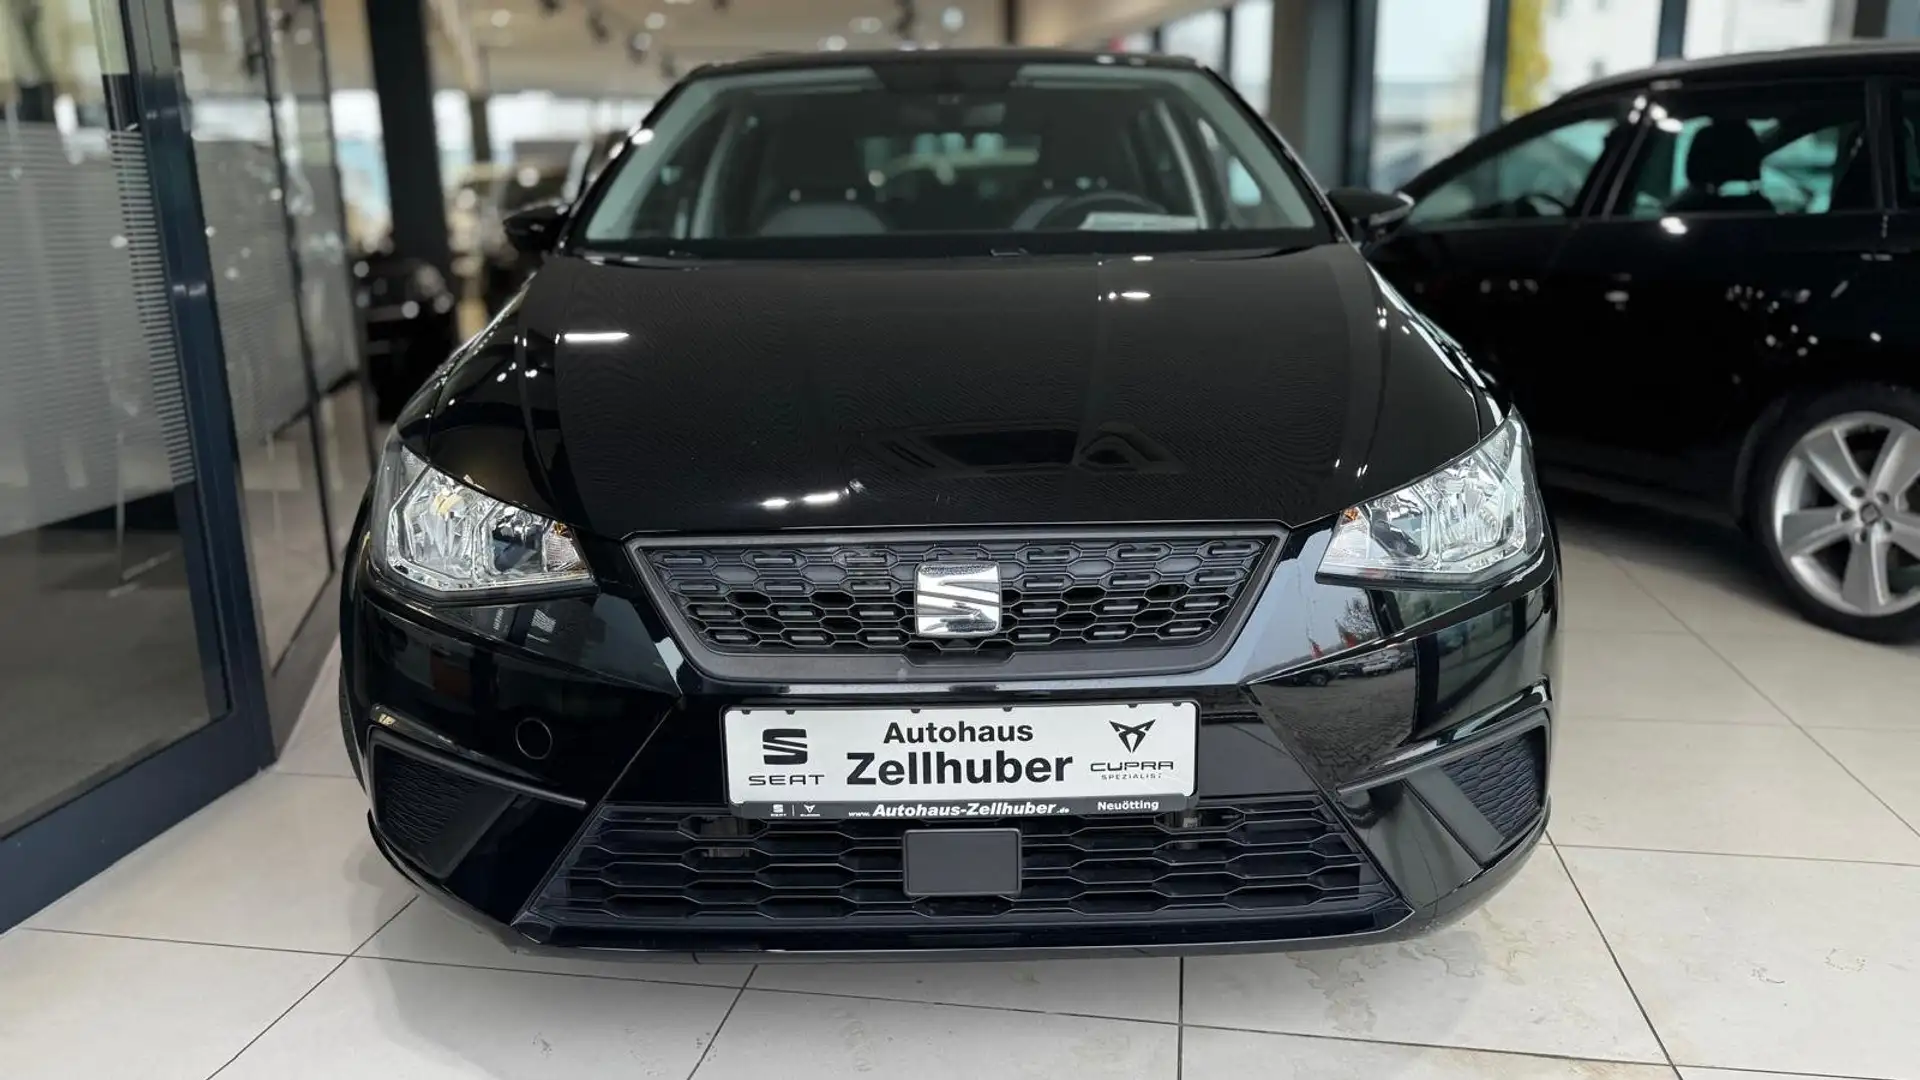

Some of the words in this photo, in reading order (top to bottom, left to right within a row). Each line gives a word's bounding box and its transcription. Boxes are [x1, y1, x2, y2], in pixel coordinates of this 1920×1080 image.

[883, 721, 1034, 744] Autohaus
[846, 750, 1073, 785] Zellhuber
[1090, 760, 1174, 773] CUPRA
[748, 774, 825, 786] SEAT
[1097, 800, 1160, 812] Neuötting
